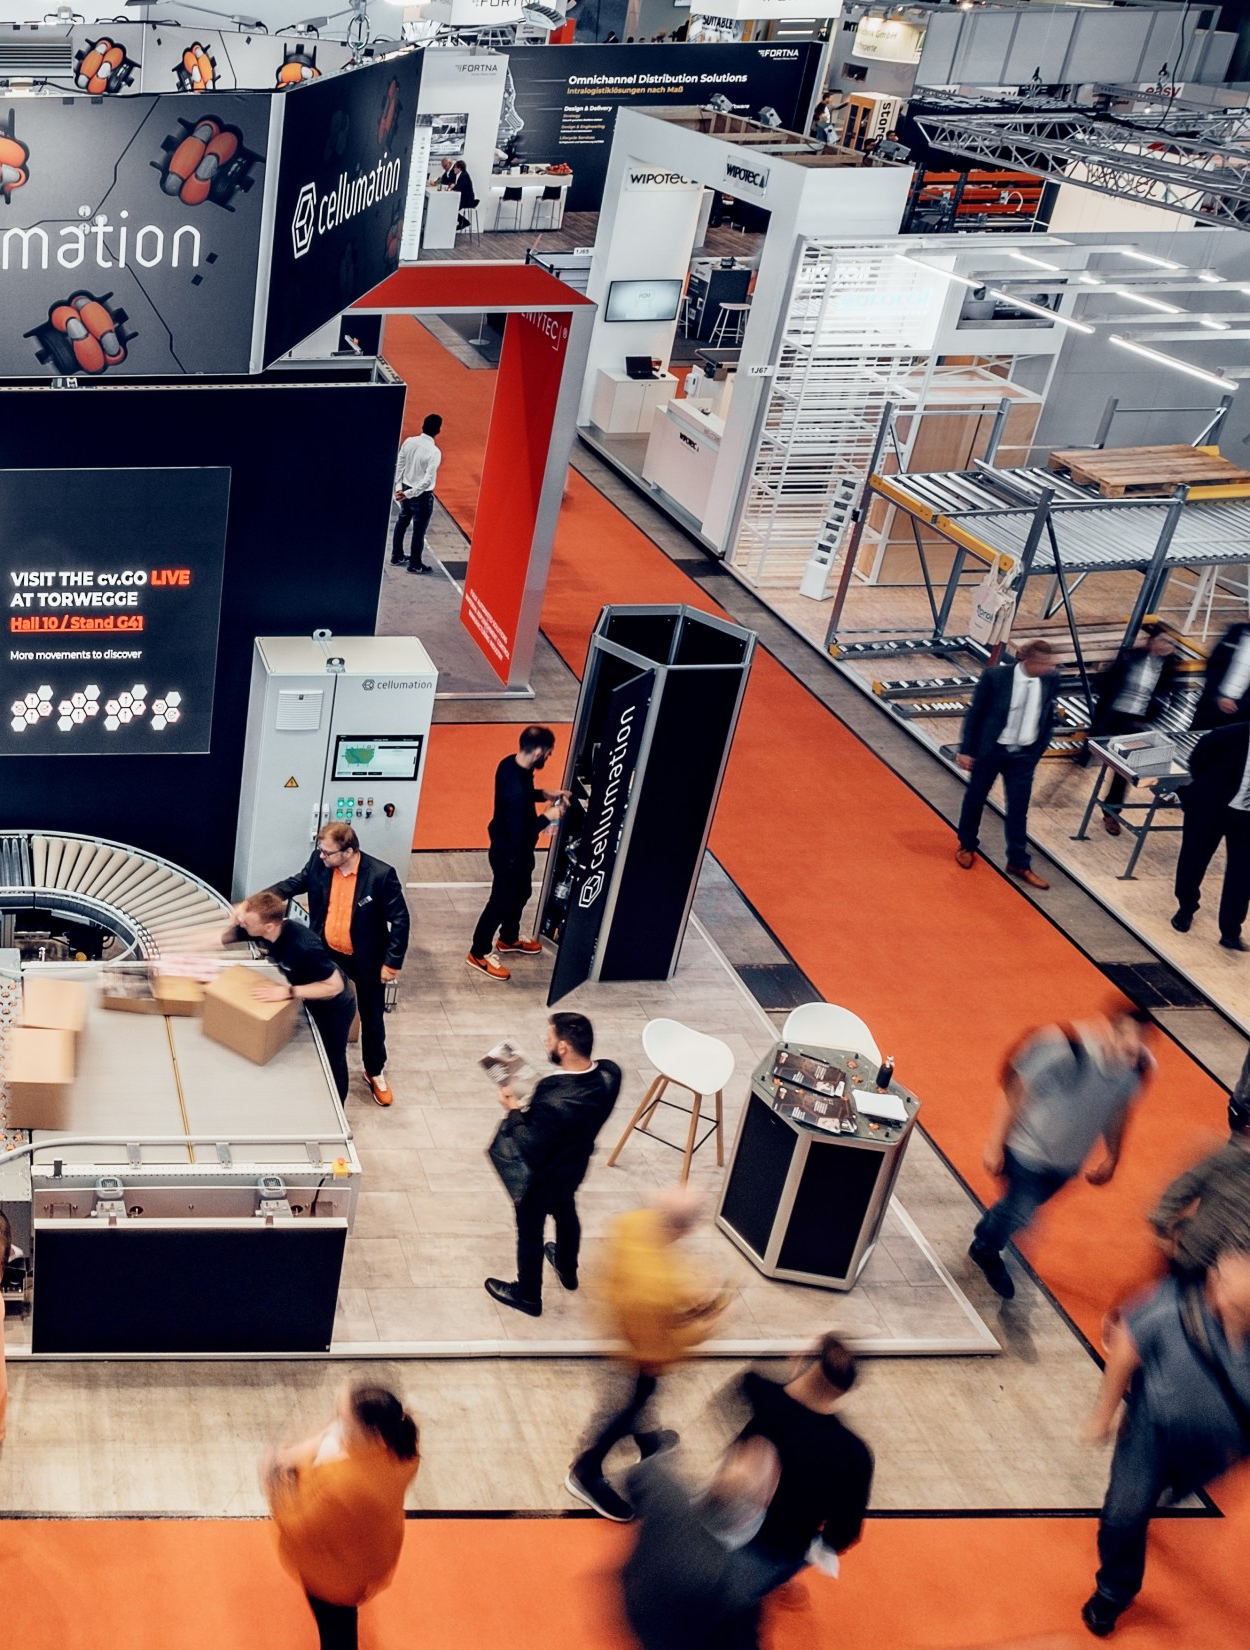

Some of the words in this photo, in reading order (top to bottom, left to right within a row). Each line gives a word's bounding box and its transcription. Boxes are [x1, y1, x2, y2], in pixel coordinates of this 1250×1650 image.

[702, 15, 733, 29] SUITABLE
[765, 49, 799, 57] FORTNA
[568, 74, 637, 85] Omnichannel
[638, 73, 698, 84] Distribution
[700, 73, 748, 83] Solutions
[566, 86, 645, 95] Intralogistiklösungen
[647, 86, 665, 94] nach
[563, 105, 583, 113] Design
[589, 105, 613, 113] Delivery
[318, 152, 401, 235] cellumation
[521, 312, 558, 340] NTYTEC
[10, 572, 56, 587] VISIT
[58, 571, 94, 586] THE
[97, 570, 147, 586] cv.GO
[151, 570, 190, 586] LIVE
[10, 592, 34, 607] AT
[37, 591, 138, 607] TORWEGGE
[11, 616, 39, 630] Hall
[42, 616, 58, 630] 10
[70, 615, 114, 629] Stand
[117, 615, 143, 629] G41
[10, 651, 34, 660] More
[35, 650, 91, 660] movements
[92, 650, 102, 659] to
[104, 649, 142, 659] discover
[377, 680, 433, 690] cellumation
[590, 705, 635, 870] cellumation
